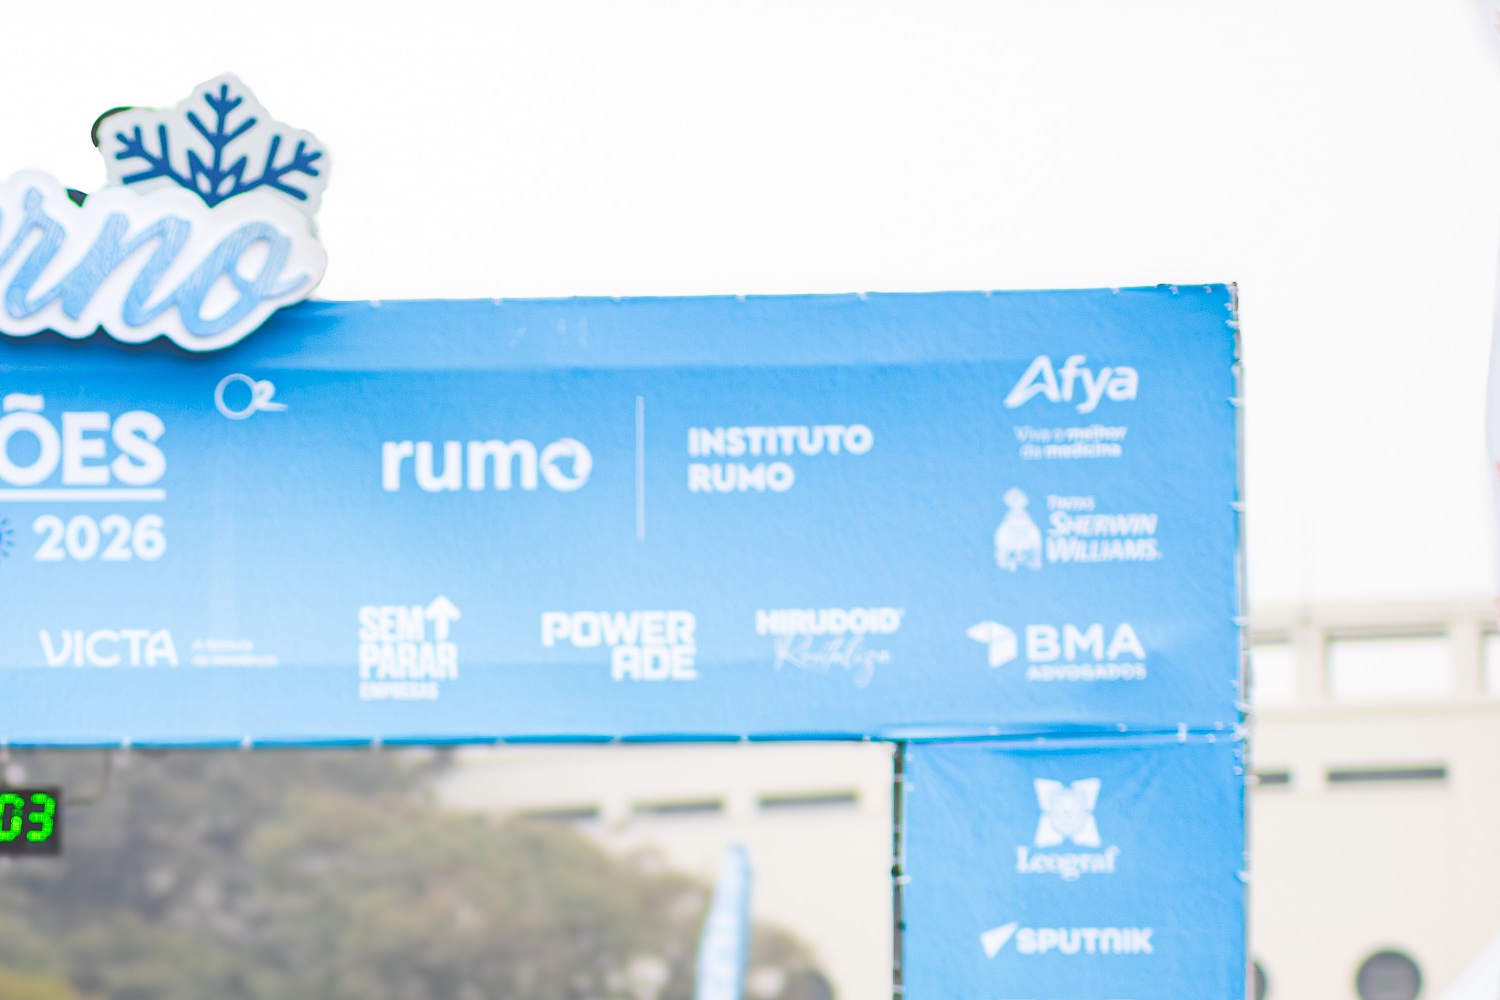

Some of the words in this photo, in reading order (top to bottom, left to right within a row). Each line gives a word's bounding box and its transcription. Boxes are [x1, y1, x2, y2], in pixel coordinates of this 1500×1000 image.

[1004, 355, 1139, 414] Afya
[688, 424, 874, 456] INSTITUTO
[381, 437, 594, 493] rumo
[688, 463, 795, 493] RUMO
[33, 514, 167, 561] 2026
[1049, 513, 1158, 537] SHERWIN
[358, 605, 424, 643] SEM
[541, 610, 697, 648] POWER
[1025, 623, 1146, 662] BMA
[39, 629, 180, 668] VICTA
[358, 642, 458, 680] PARAR
[611, 645, 698, 681] ADE
[1016, 927, 1155, 955] SPUTNIK
